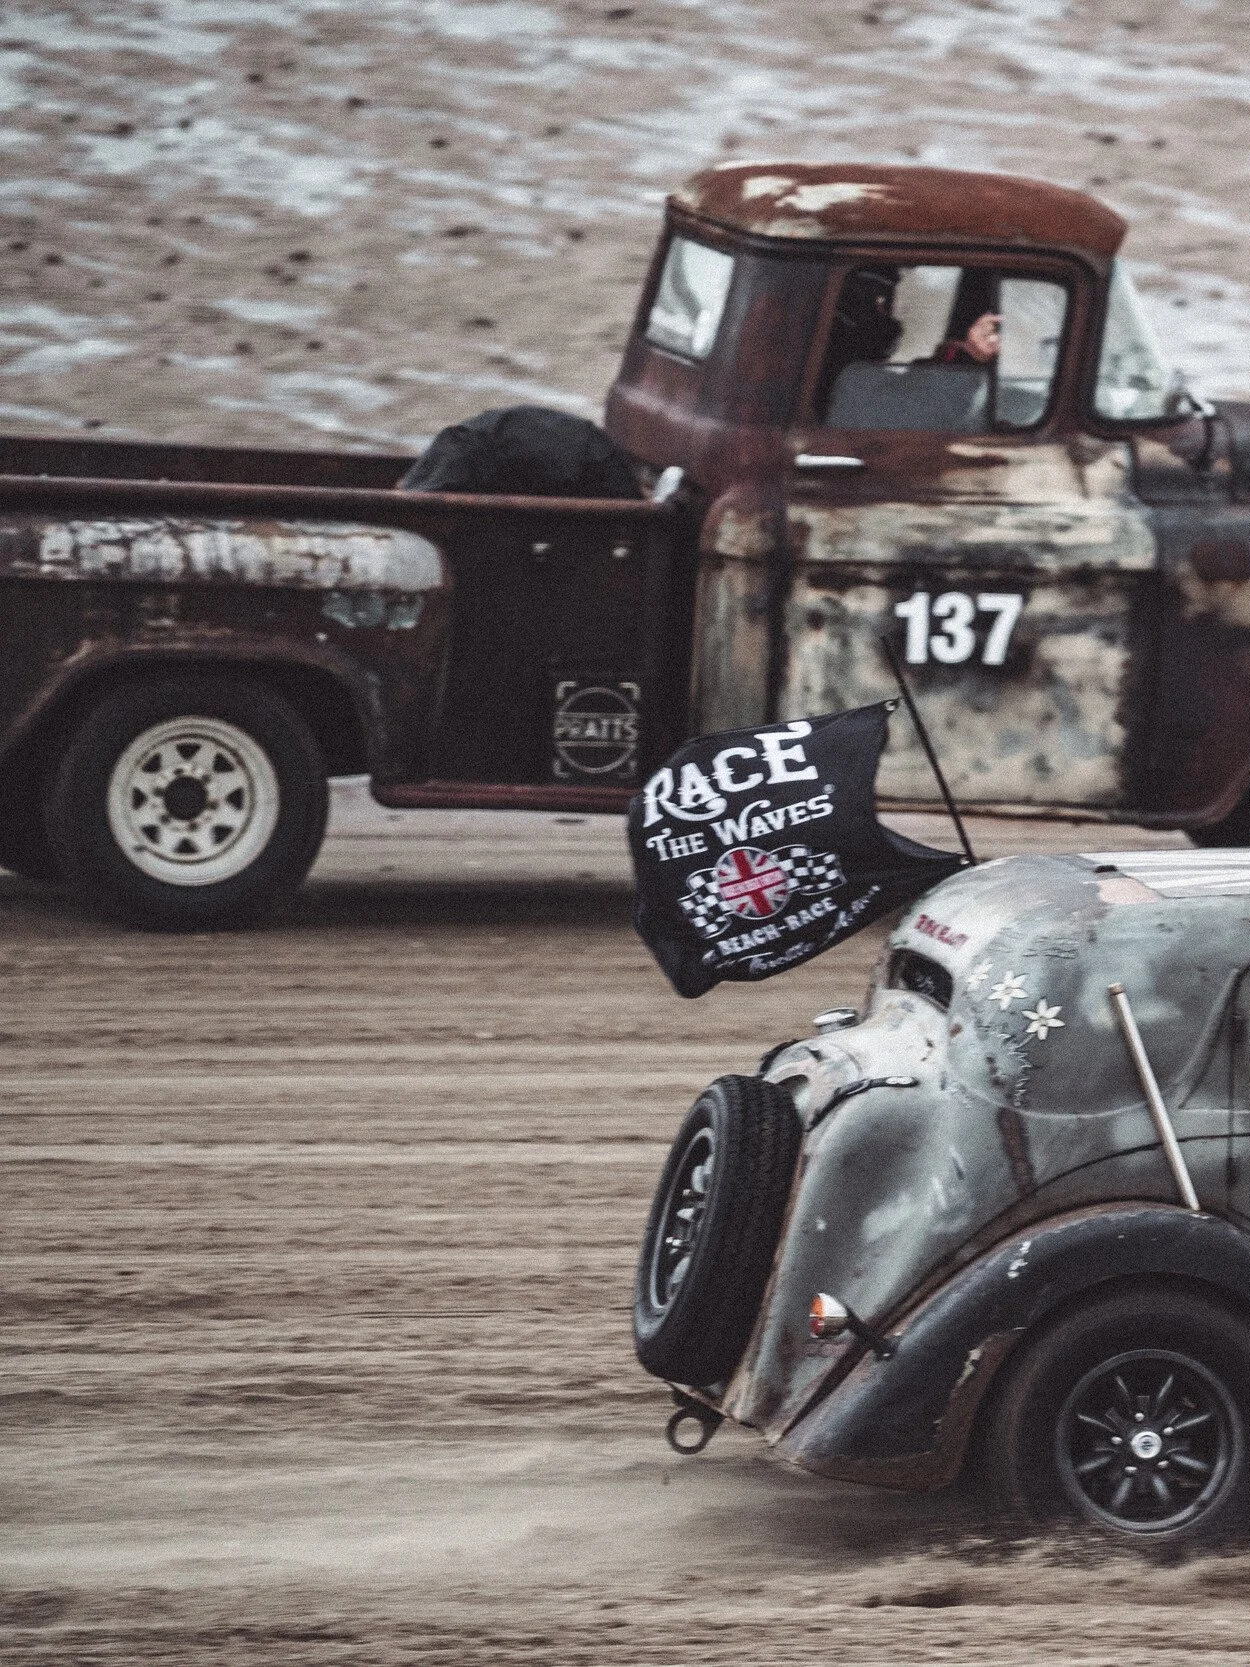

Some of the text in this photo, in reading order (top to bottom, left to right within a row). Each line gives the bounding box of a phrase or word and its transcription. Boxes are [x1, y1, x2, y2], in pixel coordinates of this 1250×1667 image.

[894, 591, 1023, 666] 137
[642, 720, 819, 828] RACE
[646, 794, 834, 862] THE WAVES
